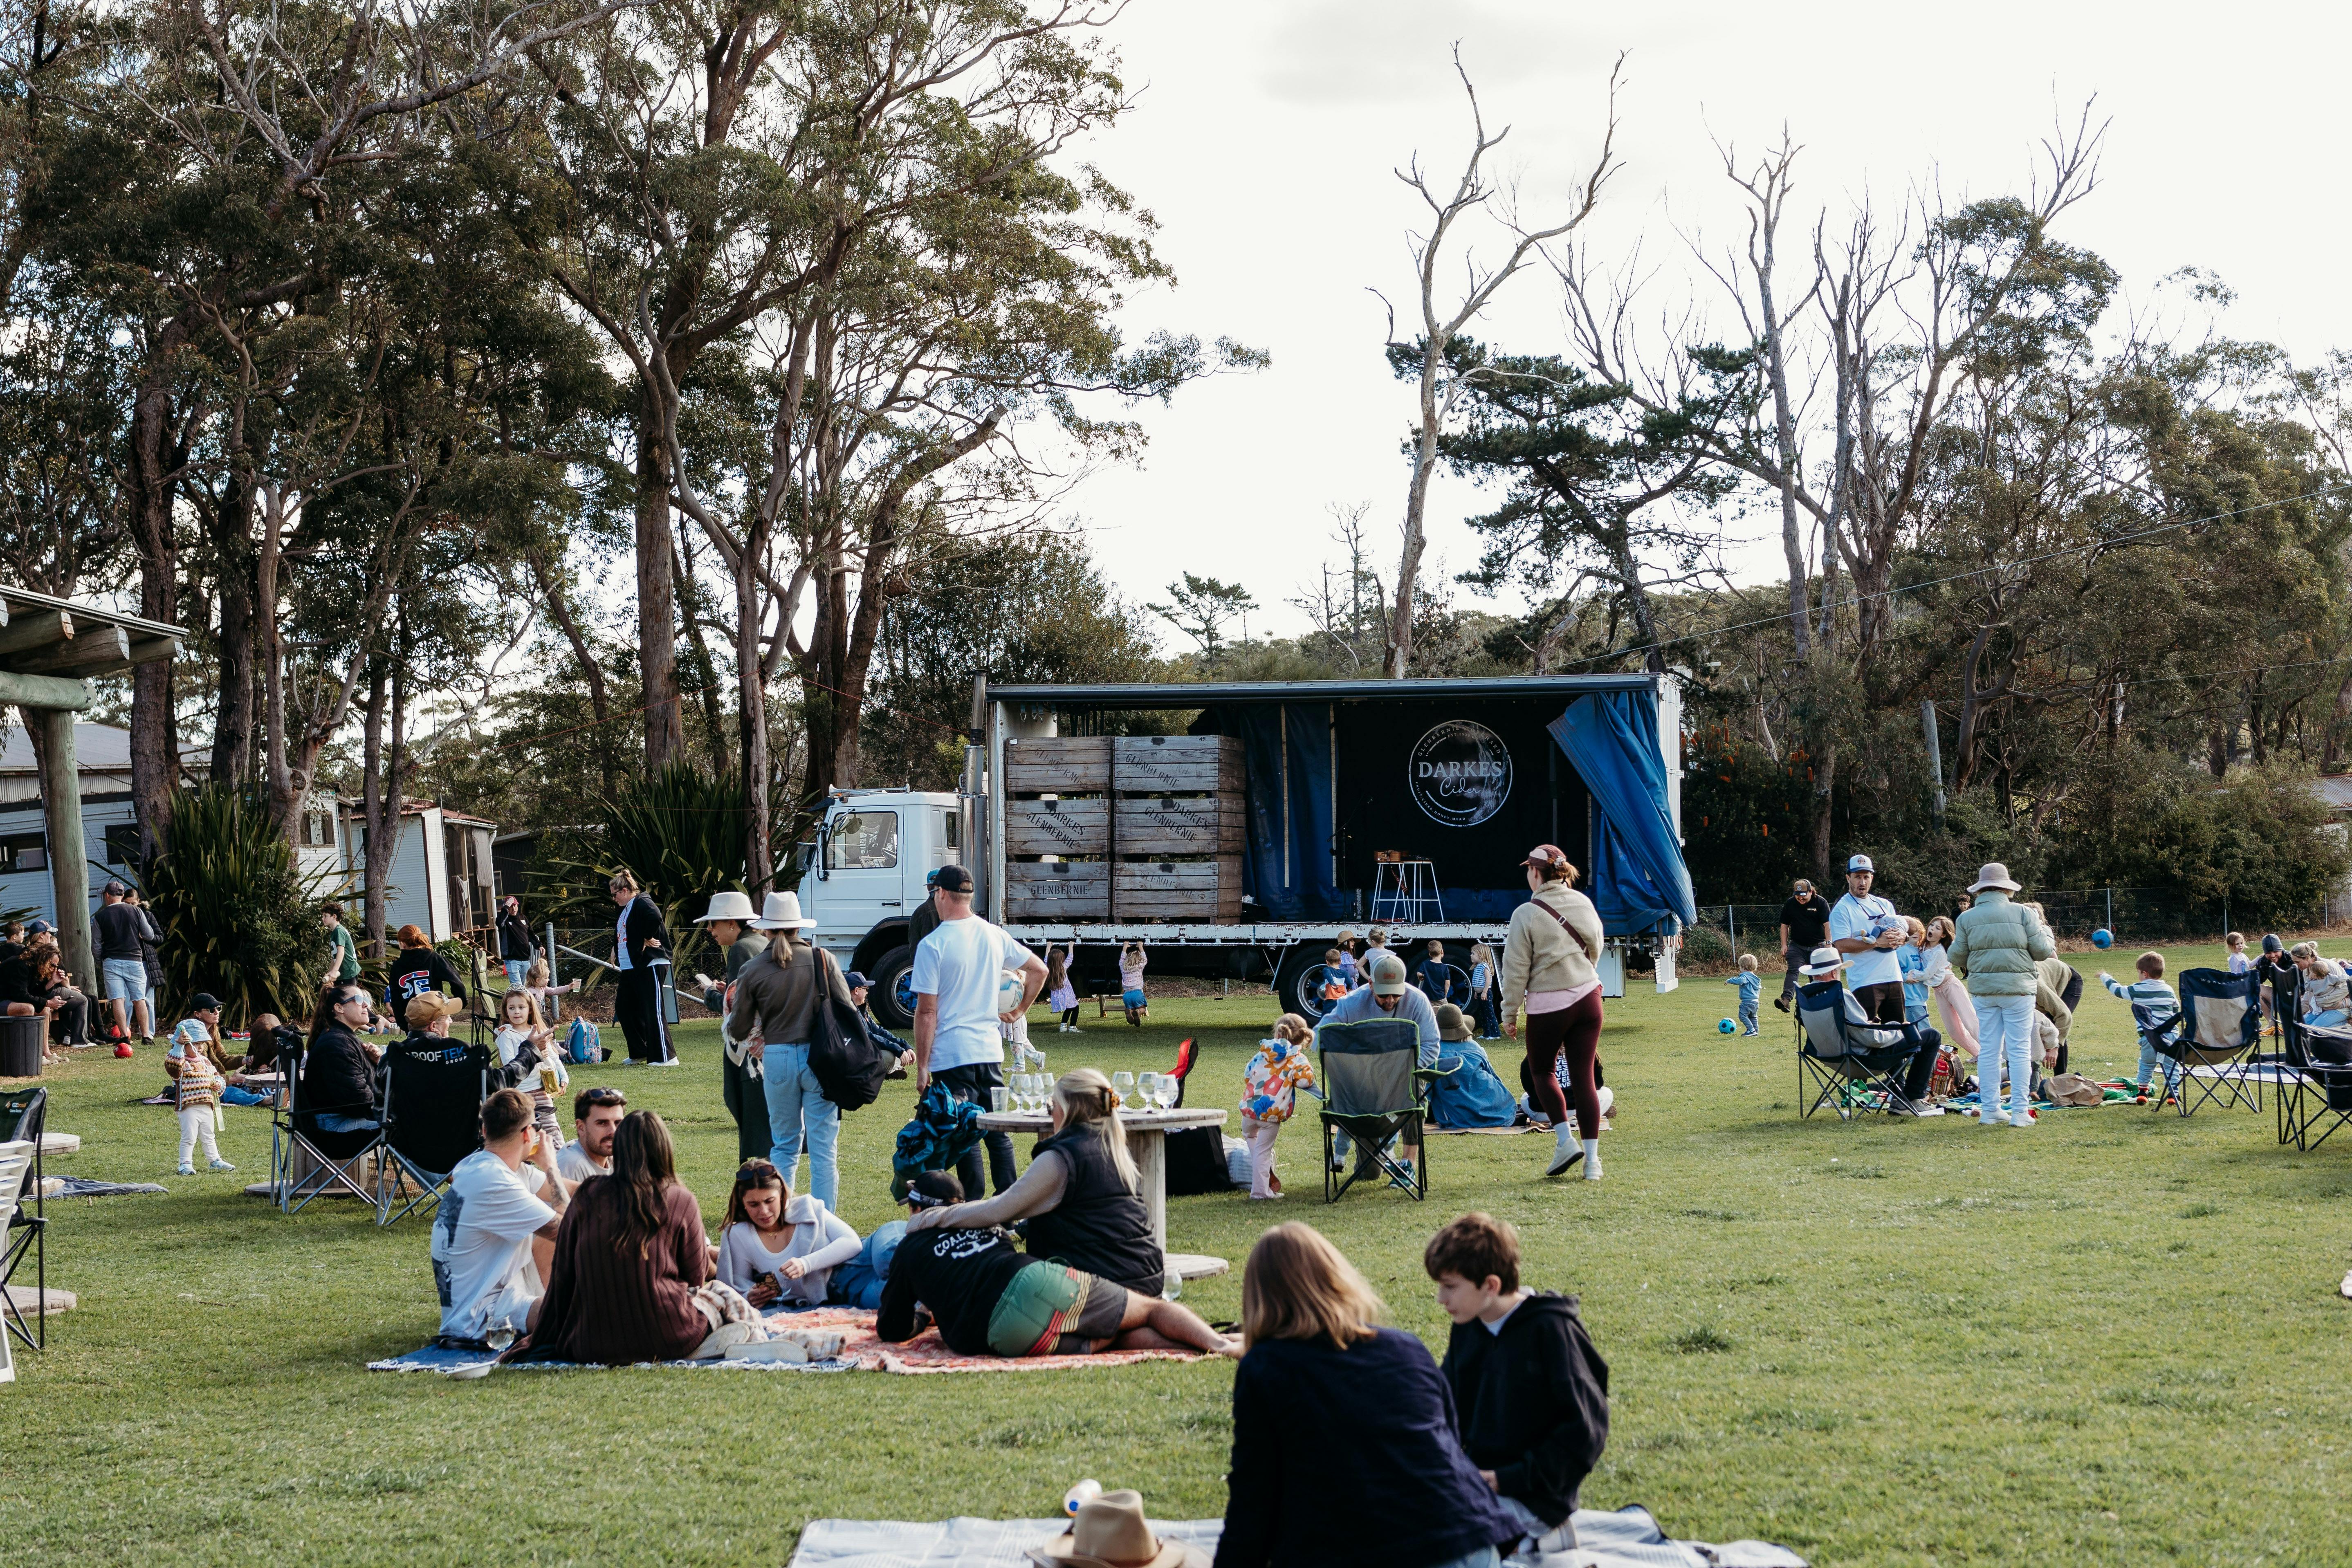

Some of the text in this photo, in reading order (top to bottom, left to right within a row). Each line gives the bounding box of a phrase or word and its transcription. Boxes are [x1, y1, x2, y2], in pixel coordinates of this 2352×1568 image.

[1418, 726, 1460, 756] GLENBERNIE
[1125, 754, 1180, 787] GLENBERNIE
[1418, 761, 1502, 777] DARKES
[1440, 777, 1481, 796] Cider
[1048, 808, 1086, 836] DARKES
[1145, 806, 1197, 843] GLENBERNIE
[1172, 801, 1210, 830] DARKES
[1026, 811, 1076, 850] GLENBERNIE
[1030, 884, 1088, 895] GLENBERNIE
[445, 1055, 467, 1064] GROUP
